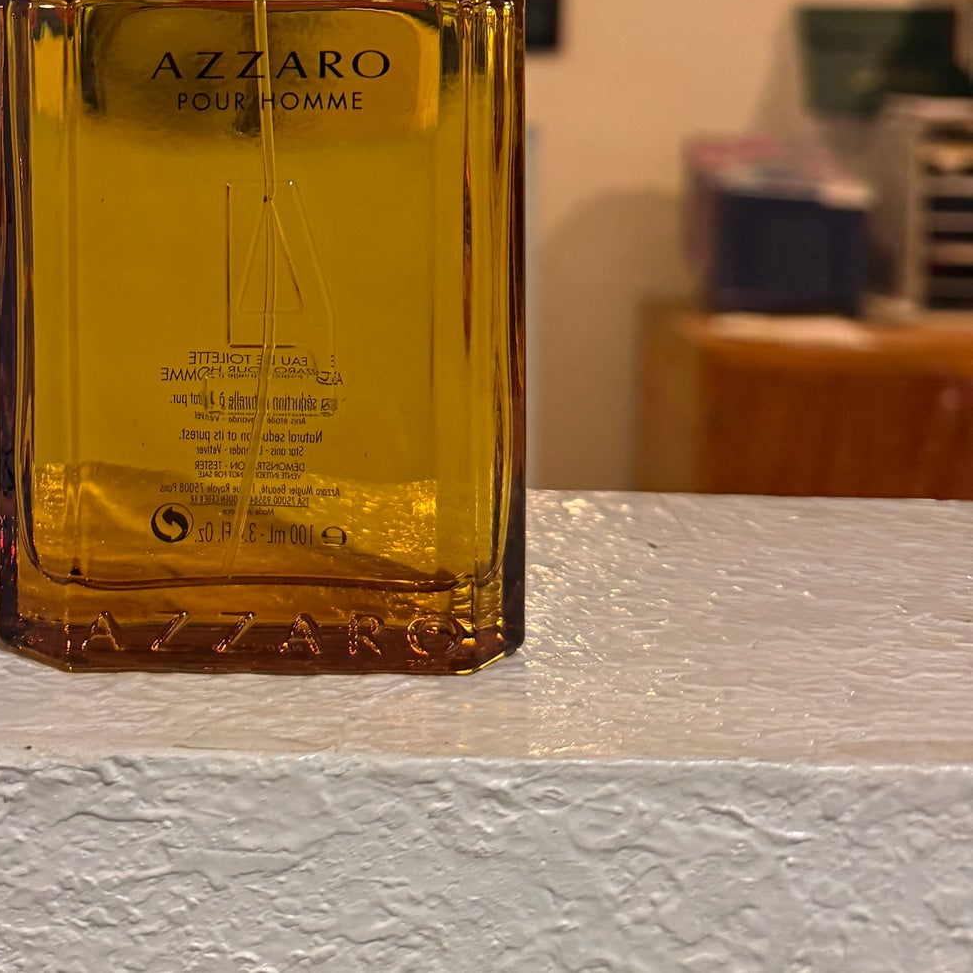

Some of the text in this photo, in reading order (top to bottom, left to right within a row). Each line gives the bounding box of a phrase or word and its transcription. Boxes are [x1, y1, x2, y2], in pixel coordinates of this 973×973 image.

[152, 50, 390, 79] AZZARO
[178, 92, 363, 111] POUR HOMME
